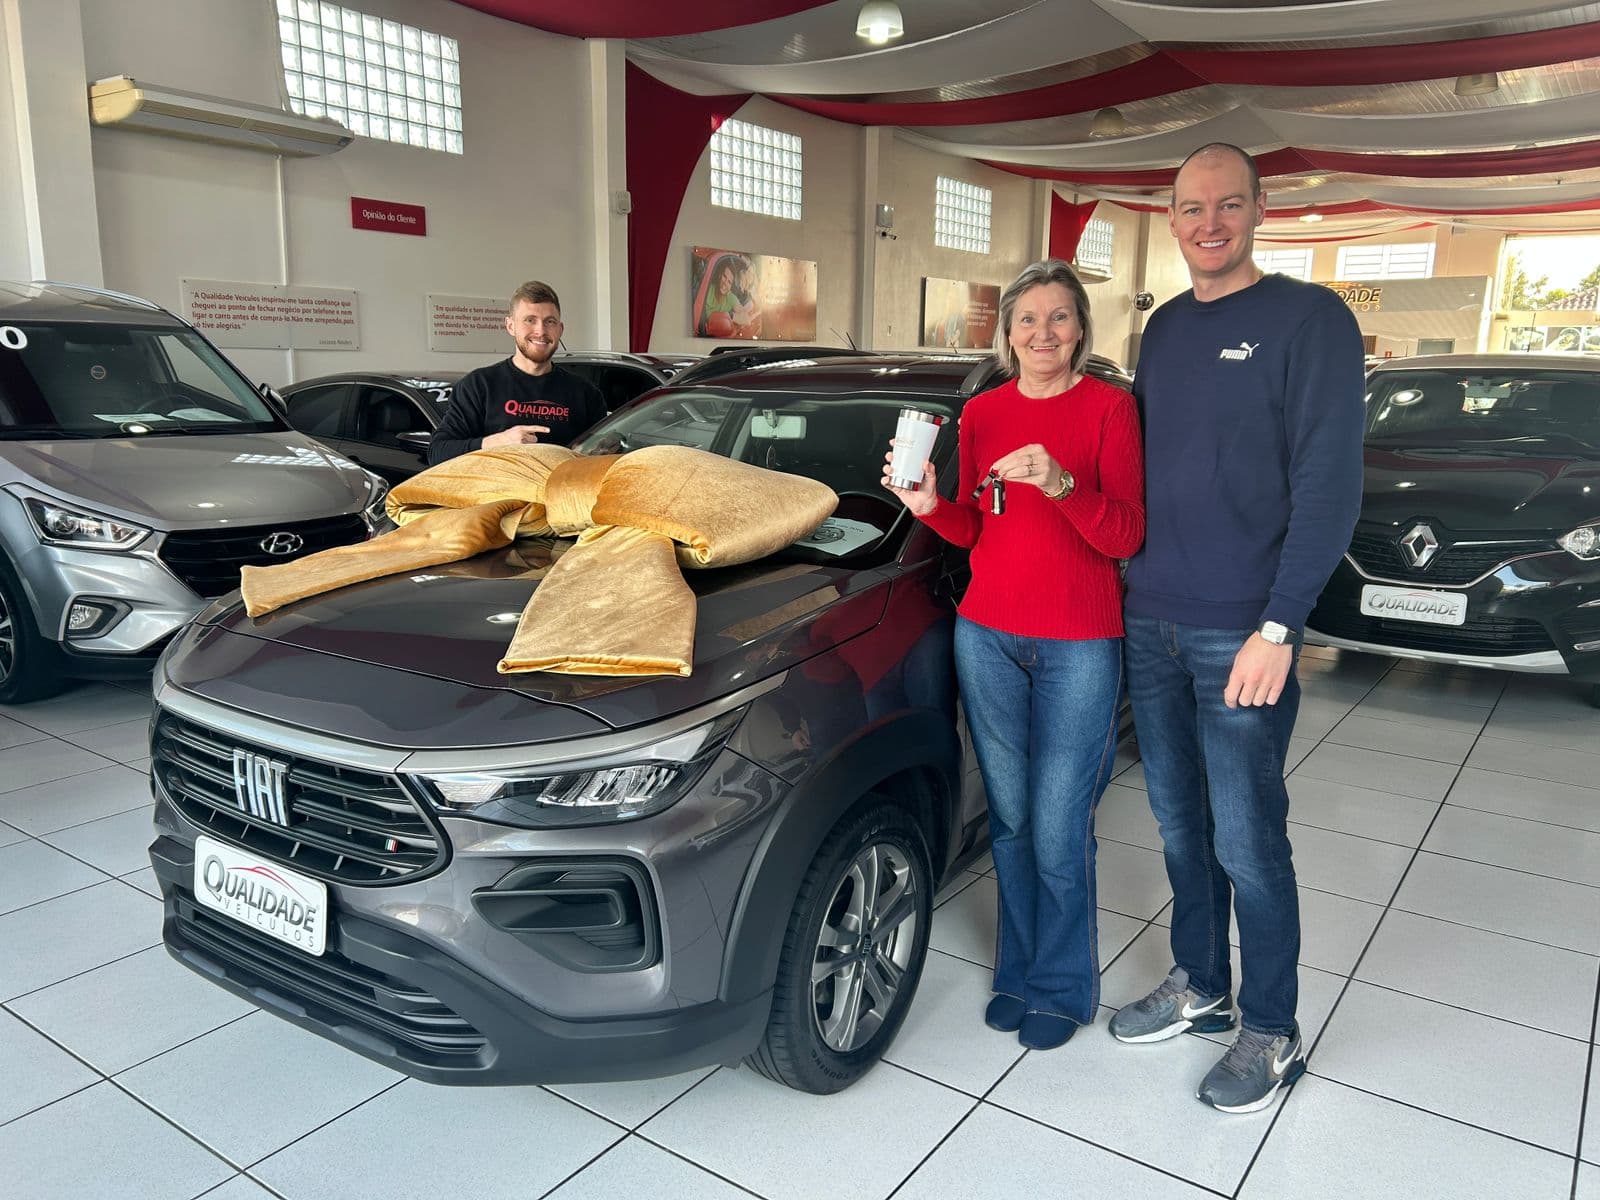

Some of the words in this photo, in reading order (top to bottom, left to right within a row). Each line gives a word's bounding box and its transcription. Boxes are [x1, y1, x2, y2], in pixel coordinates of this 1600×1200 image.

[362, 209, 386, 220] Opinião
[387, 212, 396, 222] do
[396, 214, 416, 224] Cliente
[200, 292, 234, 300] Qualidade
[191, 302, 216, 310] cheguei
[192, 312, 206, 320] ligar
[1220, 348, 1249, 360] PUMA
[504, 400, 569, 416] QUALIDADE
[1368, 594, 1459, 616] QUALIDADE
[233, 748, 290, 826] FIAT
[204, 854, 316, 933] QUALIDADE
[224, 898, 314, 948] VEICULOS
